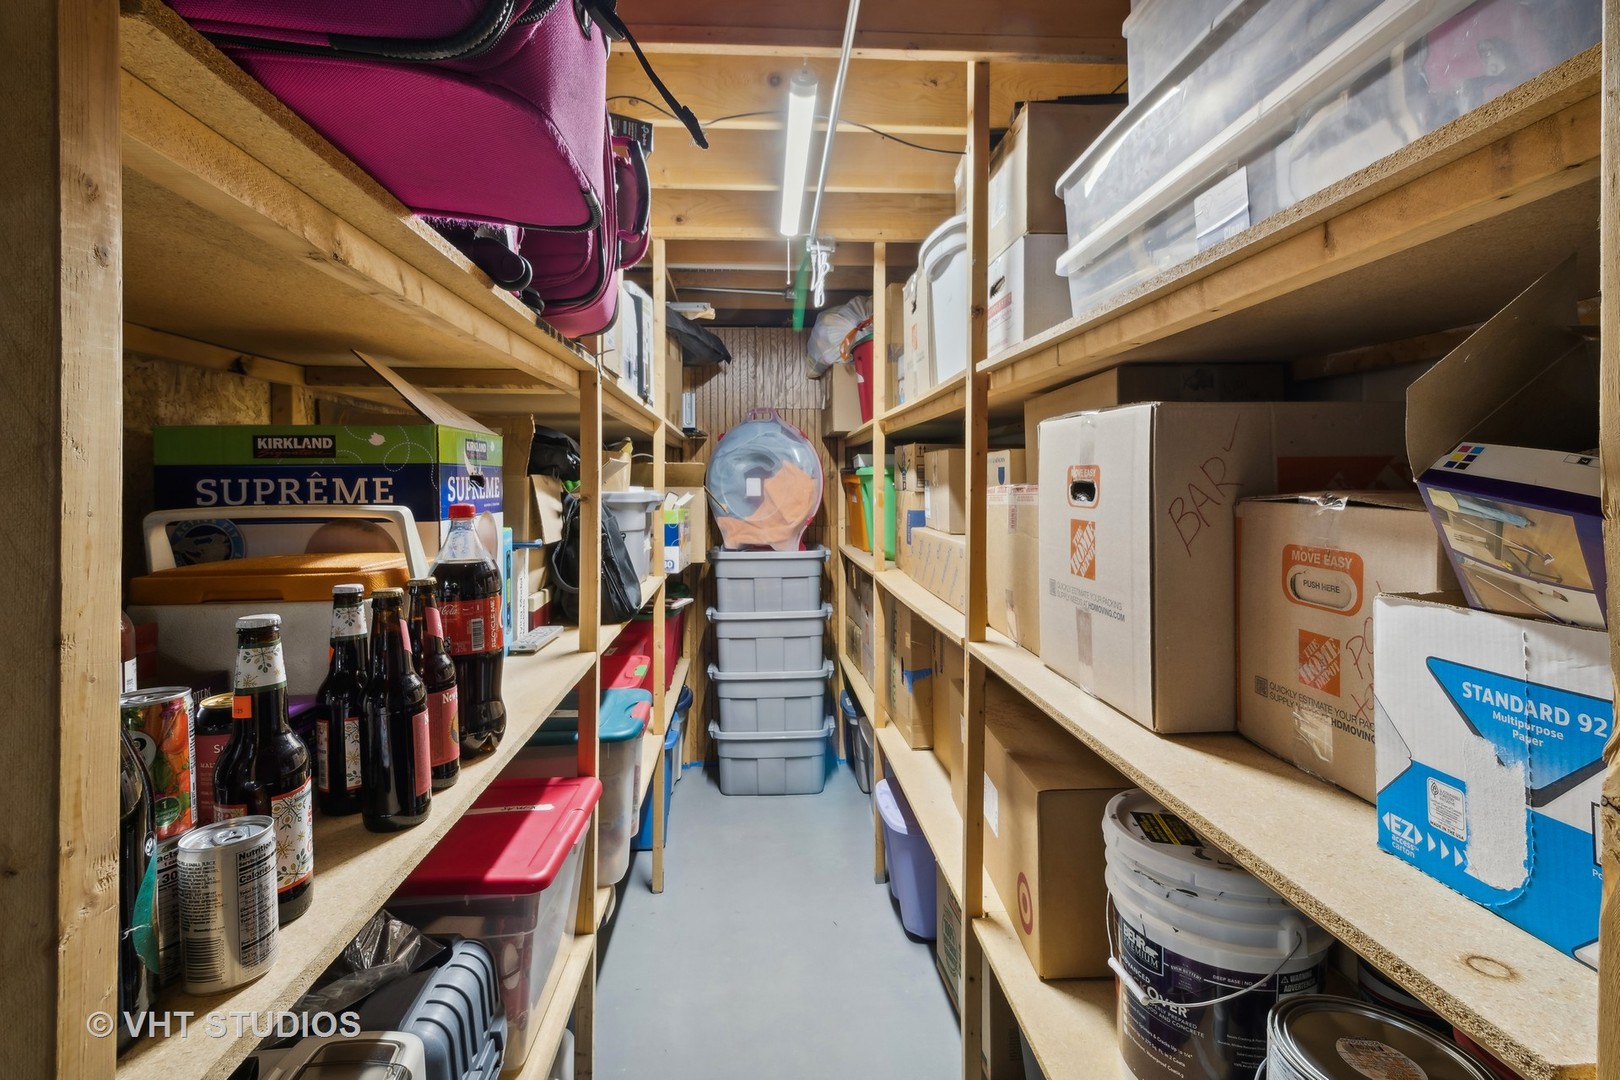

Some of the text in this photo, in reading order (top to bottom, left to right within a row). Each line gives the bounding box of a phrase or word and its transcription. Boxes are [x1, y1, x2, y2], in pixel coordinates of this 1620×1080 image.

[258, 438, 333, 449] KIRKLAND
[196, 471, 394, 506] SUPRÊME
[1070, 521, 1096, 576] HOME
[1292, 550, 1352, 569] MOVE EASY
[1303, 580, 1340, 593] PUSH HERE
[1304, 638, 1320, 658] THE
[1300, 637, 1340, 684] HOME
[1269, 692, 1294, 708] SUPPLY
[1269, 682, 1297, 699] QUICKLY
[1298, 694, 1333, 715] ESTIMATE
[1334, 708, 1358, 725] YOUR
[1462, 681, 1608, 738] STANDARD 92
[1492, 710, 1564, 740] Multipurpose
[1512, 729, 1544, 747] Paper
[1390, 813, 1414, 844] EZ
[157, 850, 178, 863] acts
[239, 840, 272, 860] Nutrition
[1392, 841, 1415, 858] carton
[239, 865, 271, 884] Calories
[1123, 922, 1146, 950] BEHR
[1123, 936, 1158, 968] PREMIUM
[1213, 974, 1227, 982] DEEP
[1159, 1013, 1171, 1023] AND
[1172, 1020, 1205, 1038] CONCRETE
[1167, 1010, 1197, 1029] PREPARED
